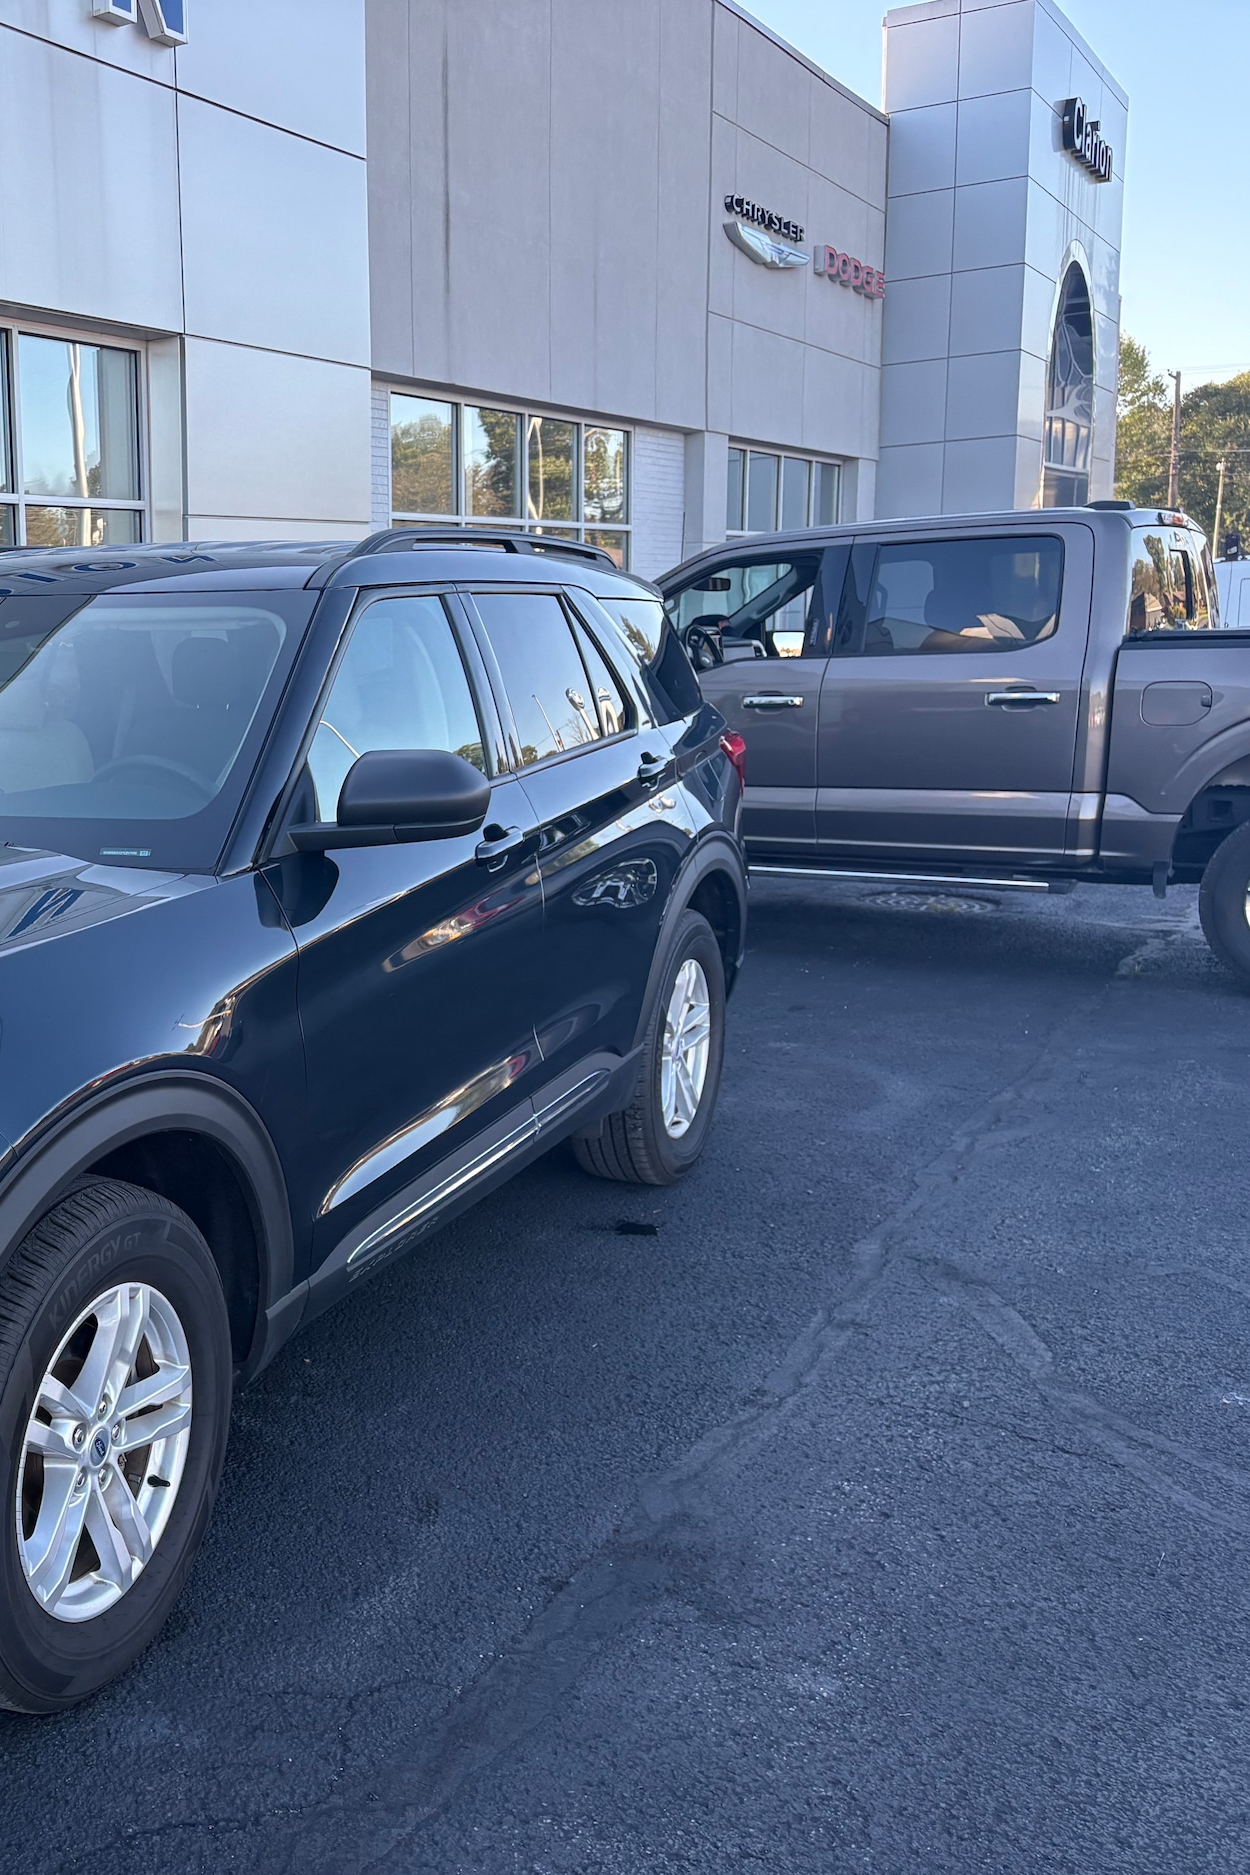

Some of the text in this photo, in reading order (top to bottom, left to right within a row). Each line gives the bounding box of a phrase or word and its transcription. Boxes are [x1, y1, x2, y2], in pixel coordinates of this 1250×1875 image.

[1071, 96, 1113, 182] Clarion
[730, 193, 806, 243] CHRYSLER
[823, 244, 886, 299] DODGE
[48, 1231, 142, 1331] KINERGY GT
